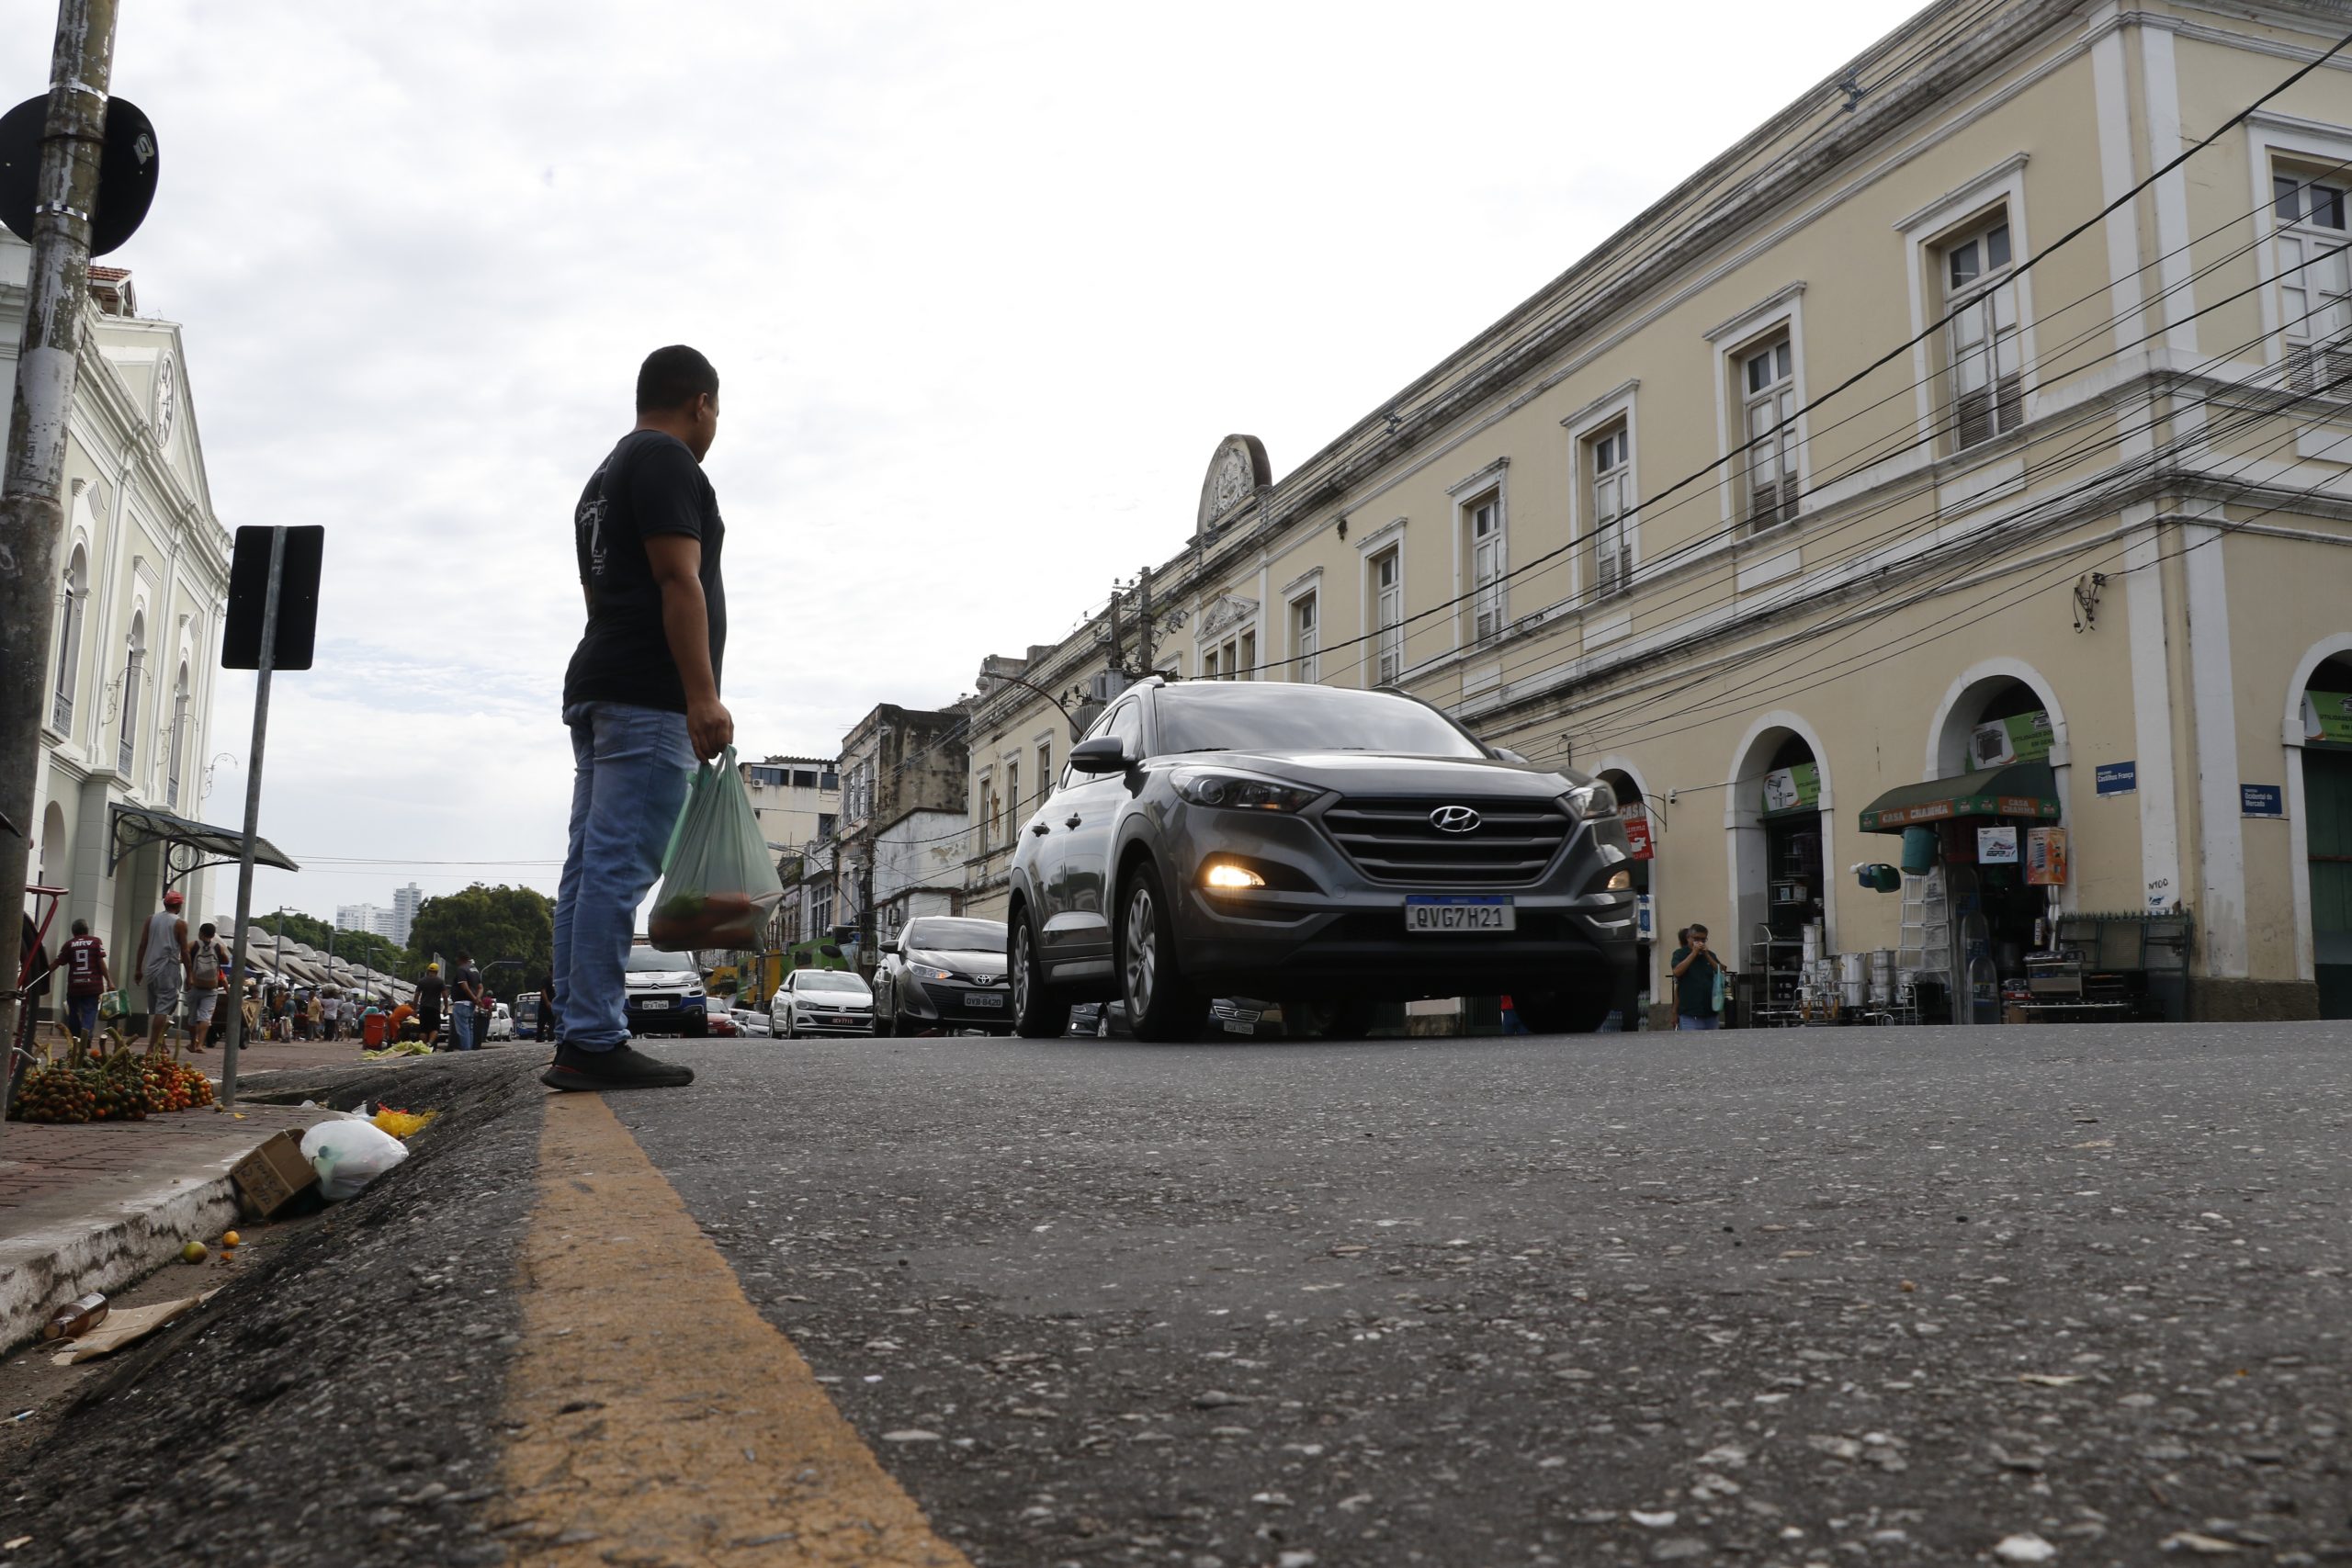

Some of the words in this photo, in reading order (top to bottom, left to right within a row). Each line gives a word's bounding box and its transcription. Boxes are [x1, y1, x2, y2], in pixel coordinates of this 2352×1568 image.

[2008, 798, 2029, 807] CASA
[1883, 811, 1905, 823] CASA
[1417, 907, 1503, 928] QVG7H21
[71, 940, 93, 948] MRV
[75, 949, 89, 971] 9
